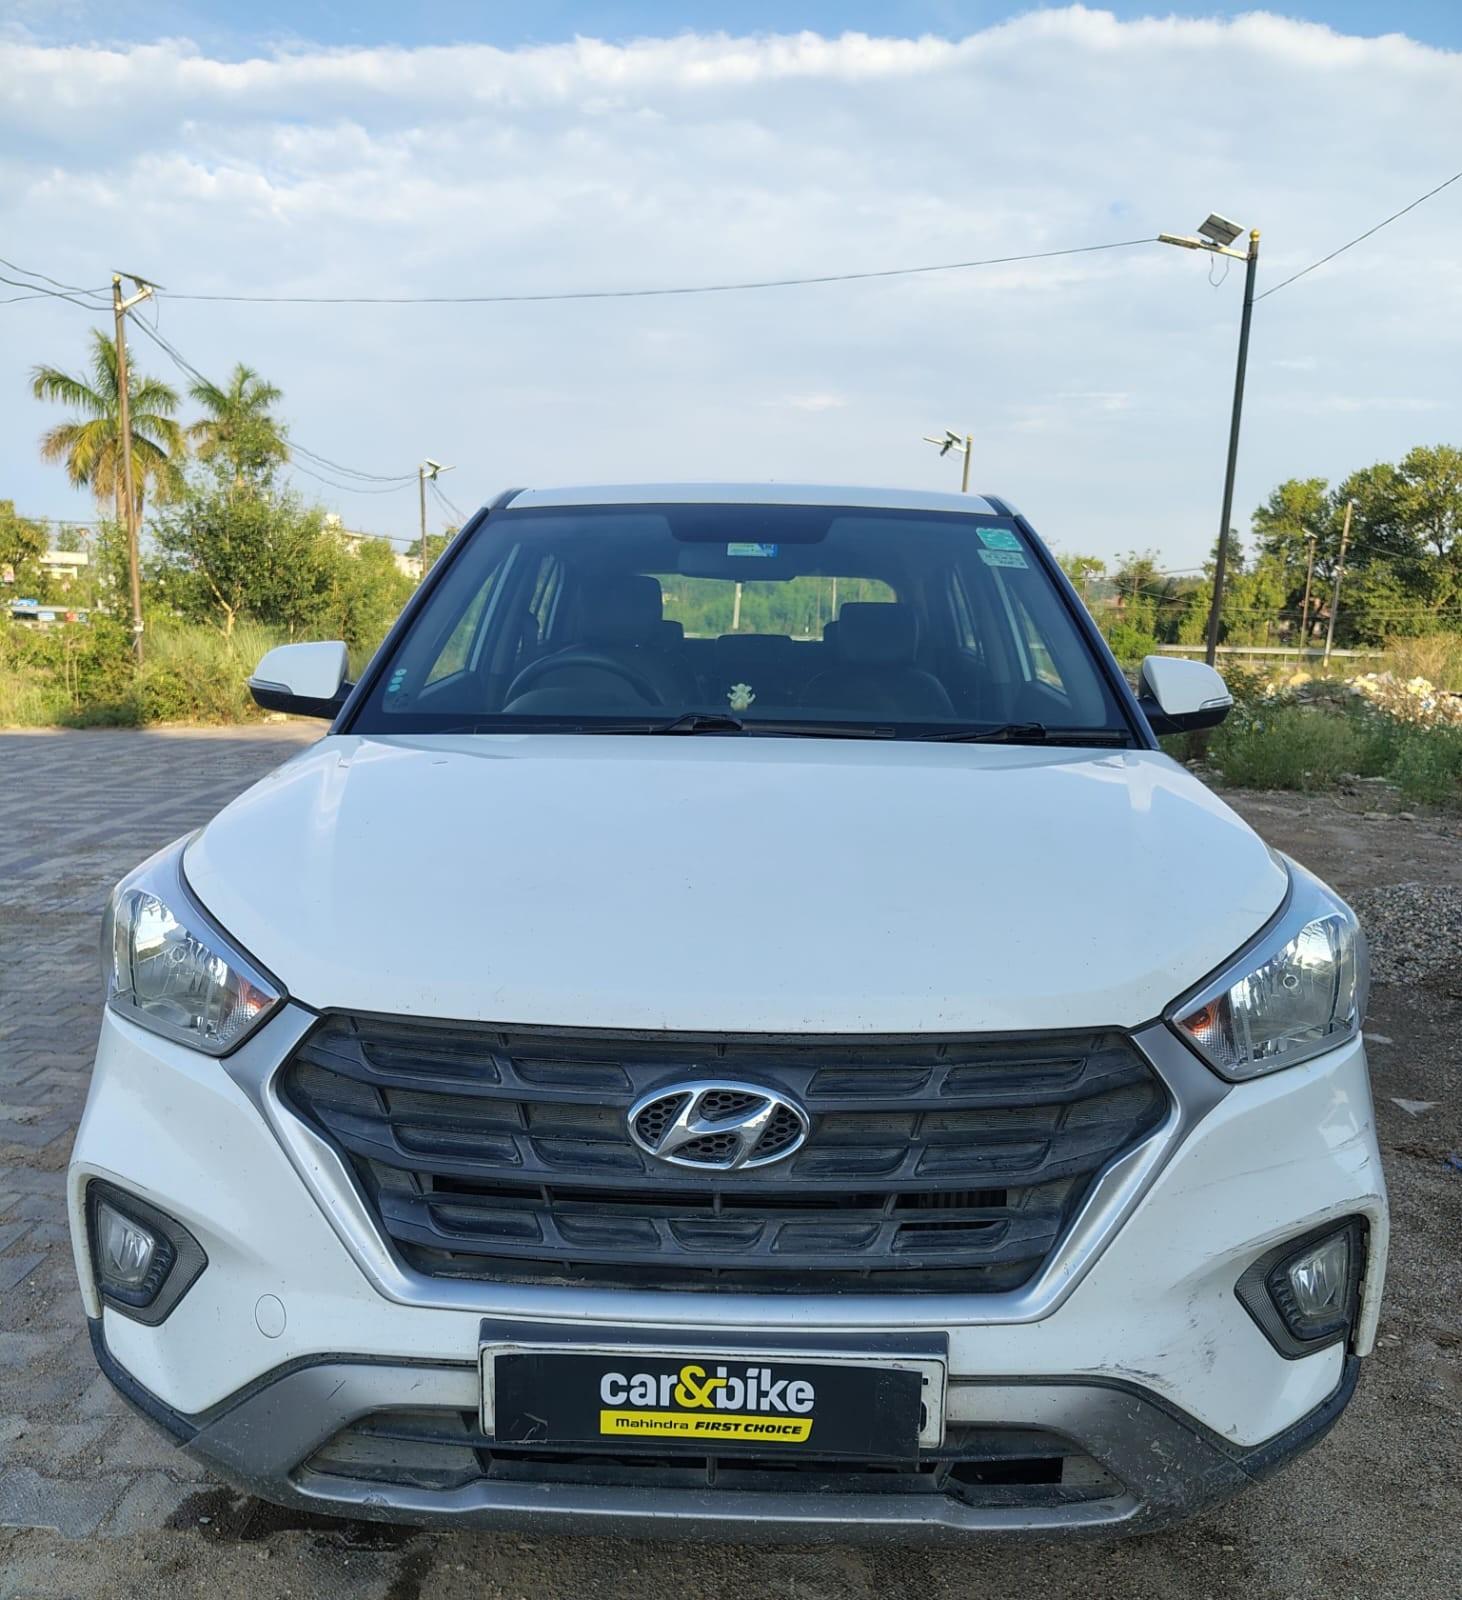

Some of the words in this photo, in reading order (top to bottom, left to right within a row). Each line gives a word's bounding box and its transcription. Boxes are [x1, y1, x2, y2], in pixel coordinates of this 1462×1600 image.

[600, 1365, 815, 1413] car&bike
[615, 1418, 689, 1430] Mahindra
[694, 1421, 742, 1432] FIRST
[743, 1423, 802, 1435] CHOICE
